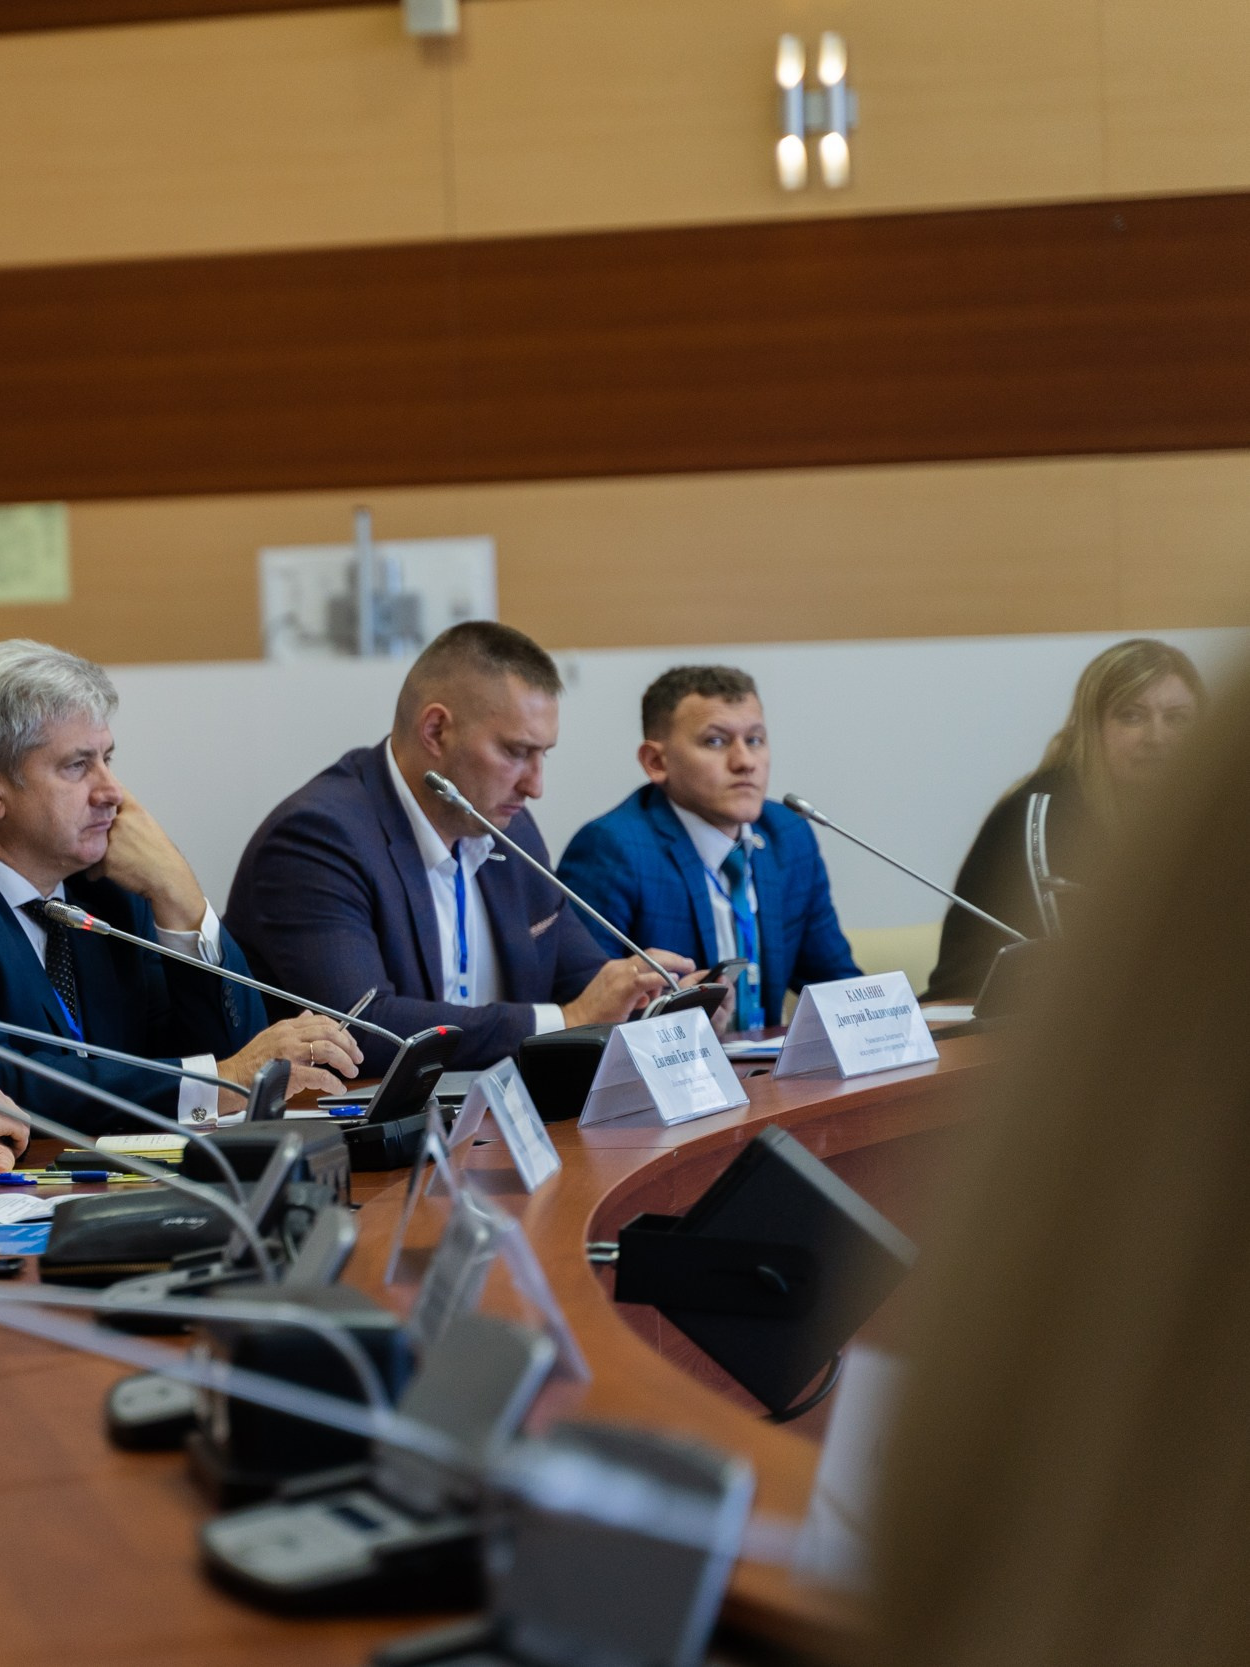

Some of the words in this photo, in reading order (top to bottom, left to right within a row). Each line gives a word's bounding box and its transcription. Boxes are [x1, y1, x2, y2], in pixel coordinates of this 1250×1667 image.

[845, 984, 886, 1003] КАМАНИН
[834, 1009, 867, 1028] Дмитрий
[864, 1004, 912, 1020] Владимирович
